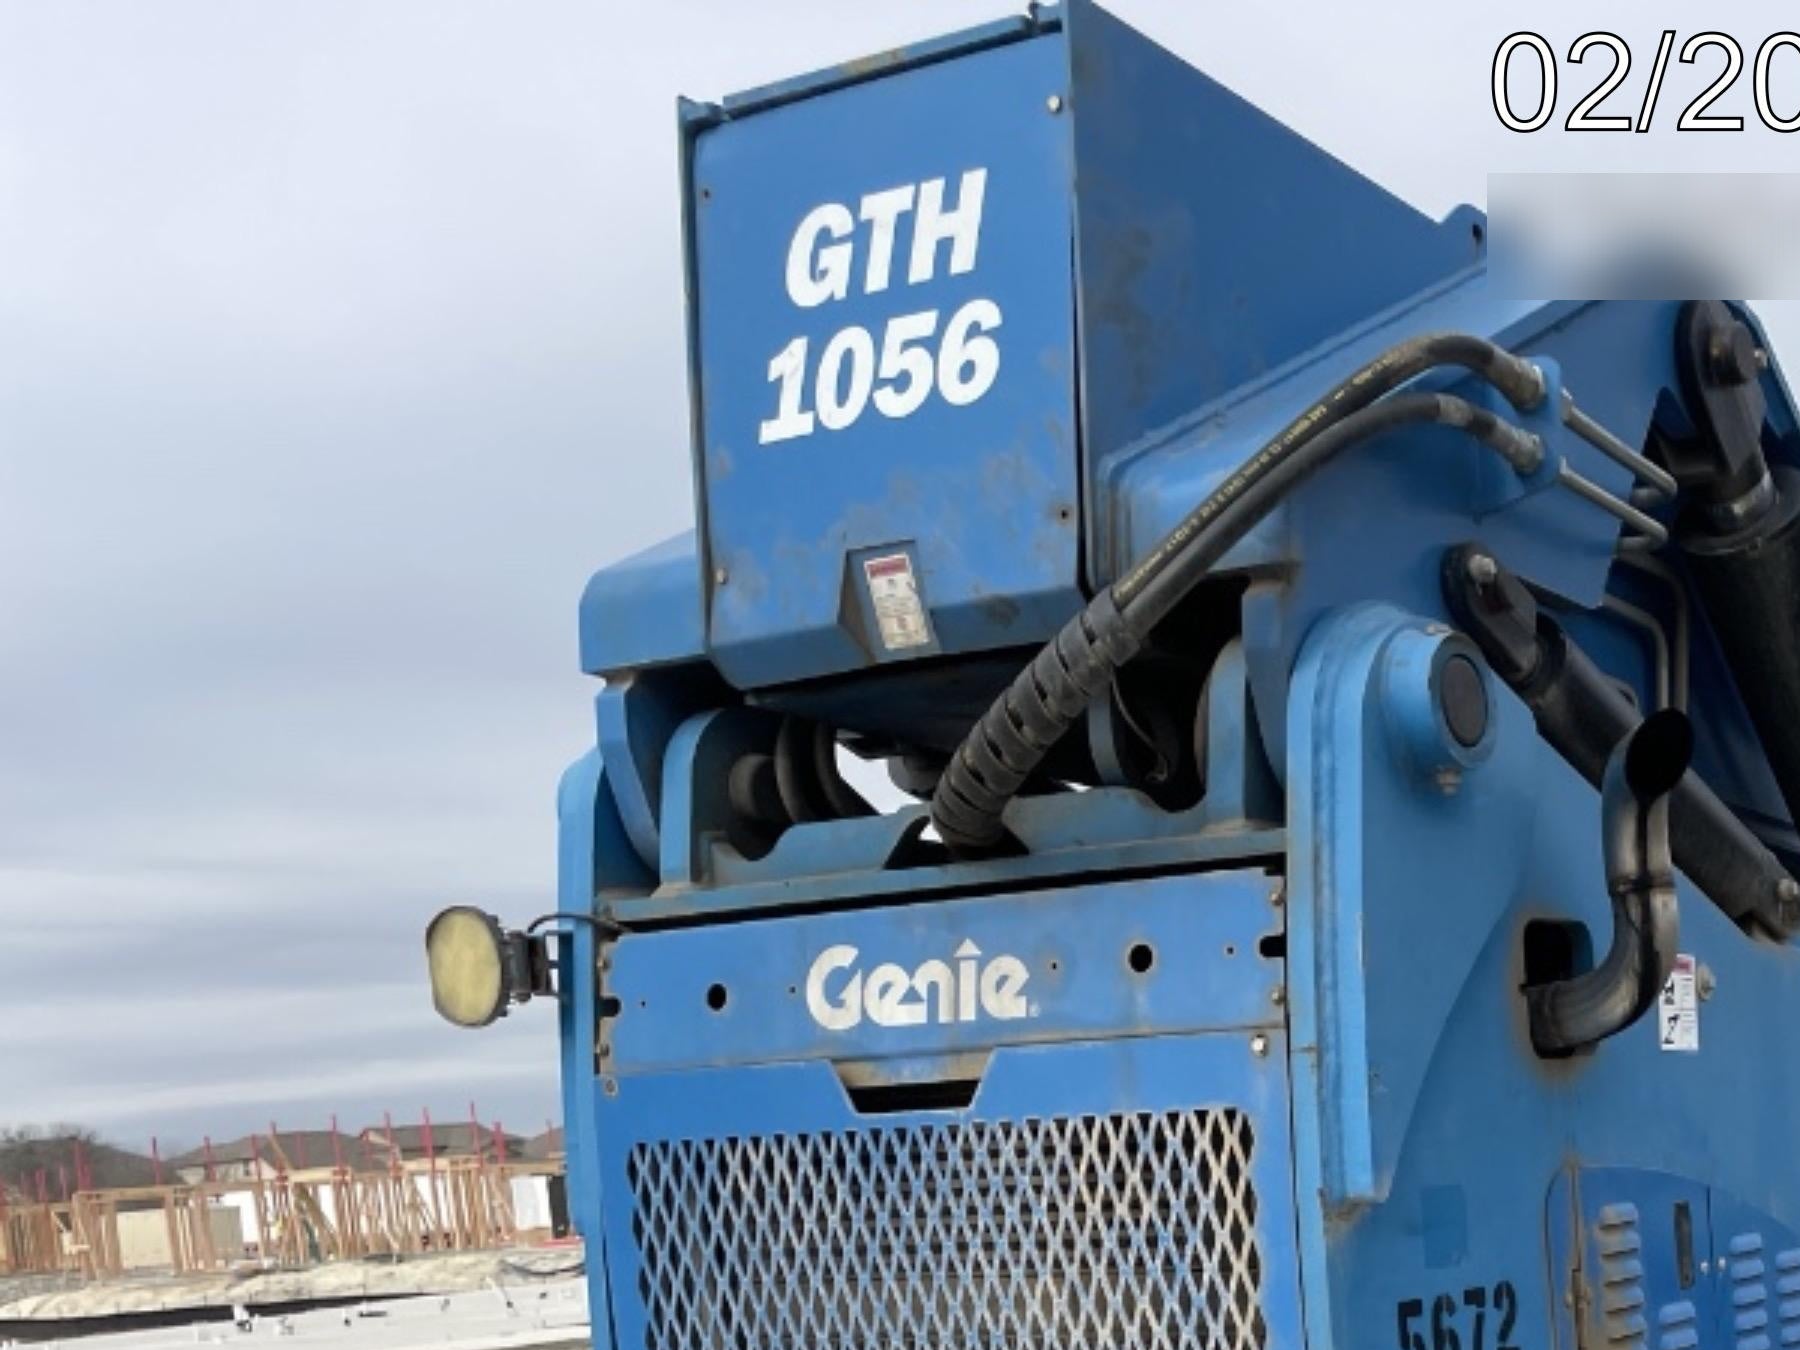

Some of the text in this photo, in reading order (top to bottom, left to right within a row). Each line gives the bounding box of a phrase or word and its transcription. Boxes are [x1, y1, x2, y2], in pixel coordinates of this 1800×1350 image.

[785, 168, 988, 307] GTH
[758, 299, 1002, 444] 1056
[805, 938, 1031, 1031] Genie
